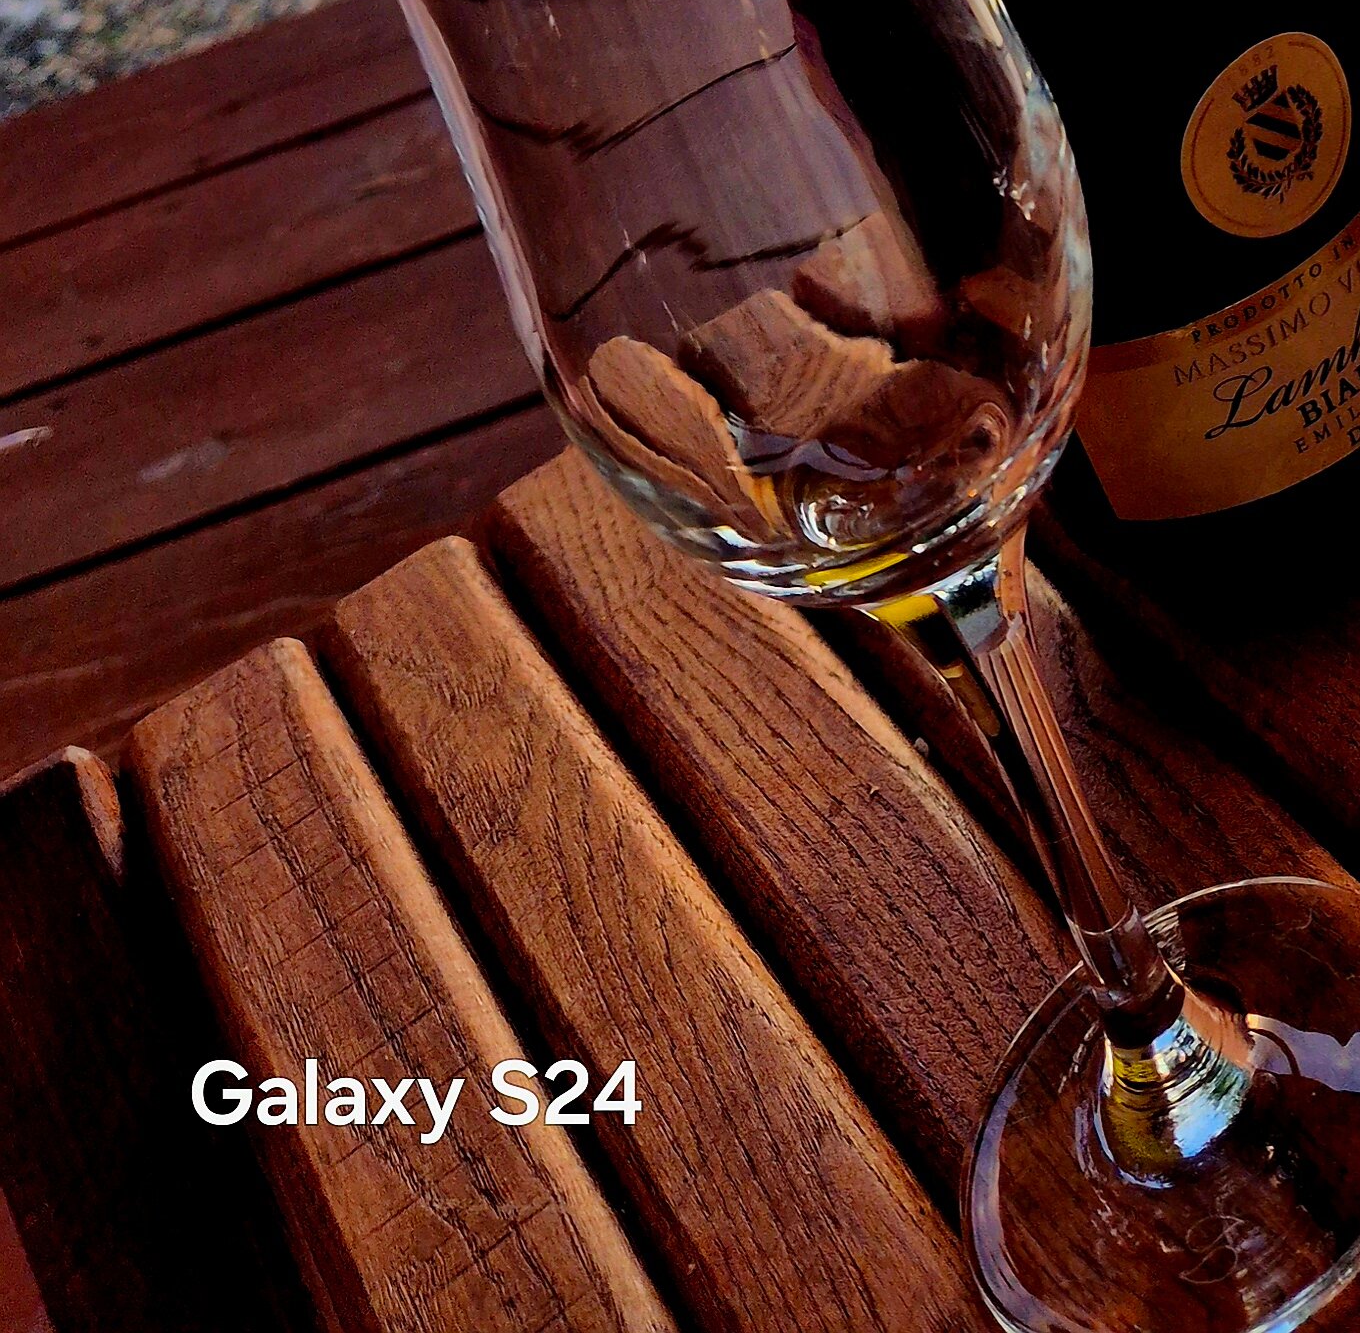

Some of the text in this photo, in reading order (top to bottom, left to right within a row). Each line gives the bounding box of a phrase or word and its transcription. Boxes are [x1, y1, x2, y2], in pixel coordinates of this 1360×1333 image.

[1173, 292, 1331, 387] MASSIMO
[1191, 262, 1322, 344] PRODOTTO
[1332, 235, 1354, 261] IN
